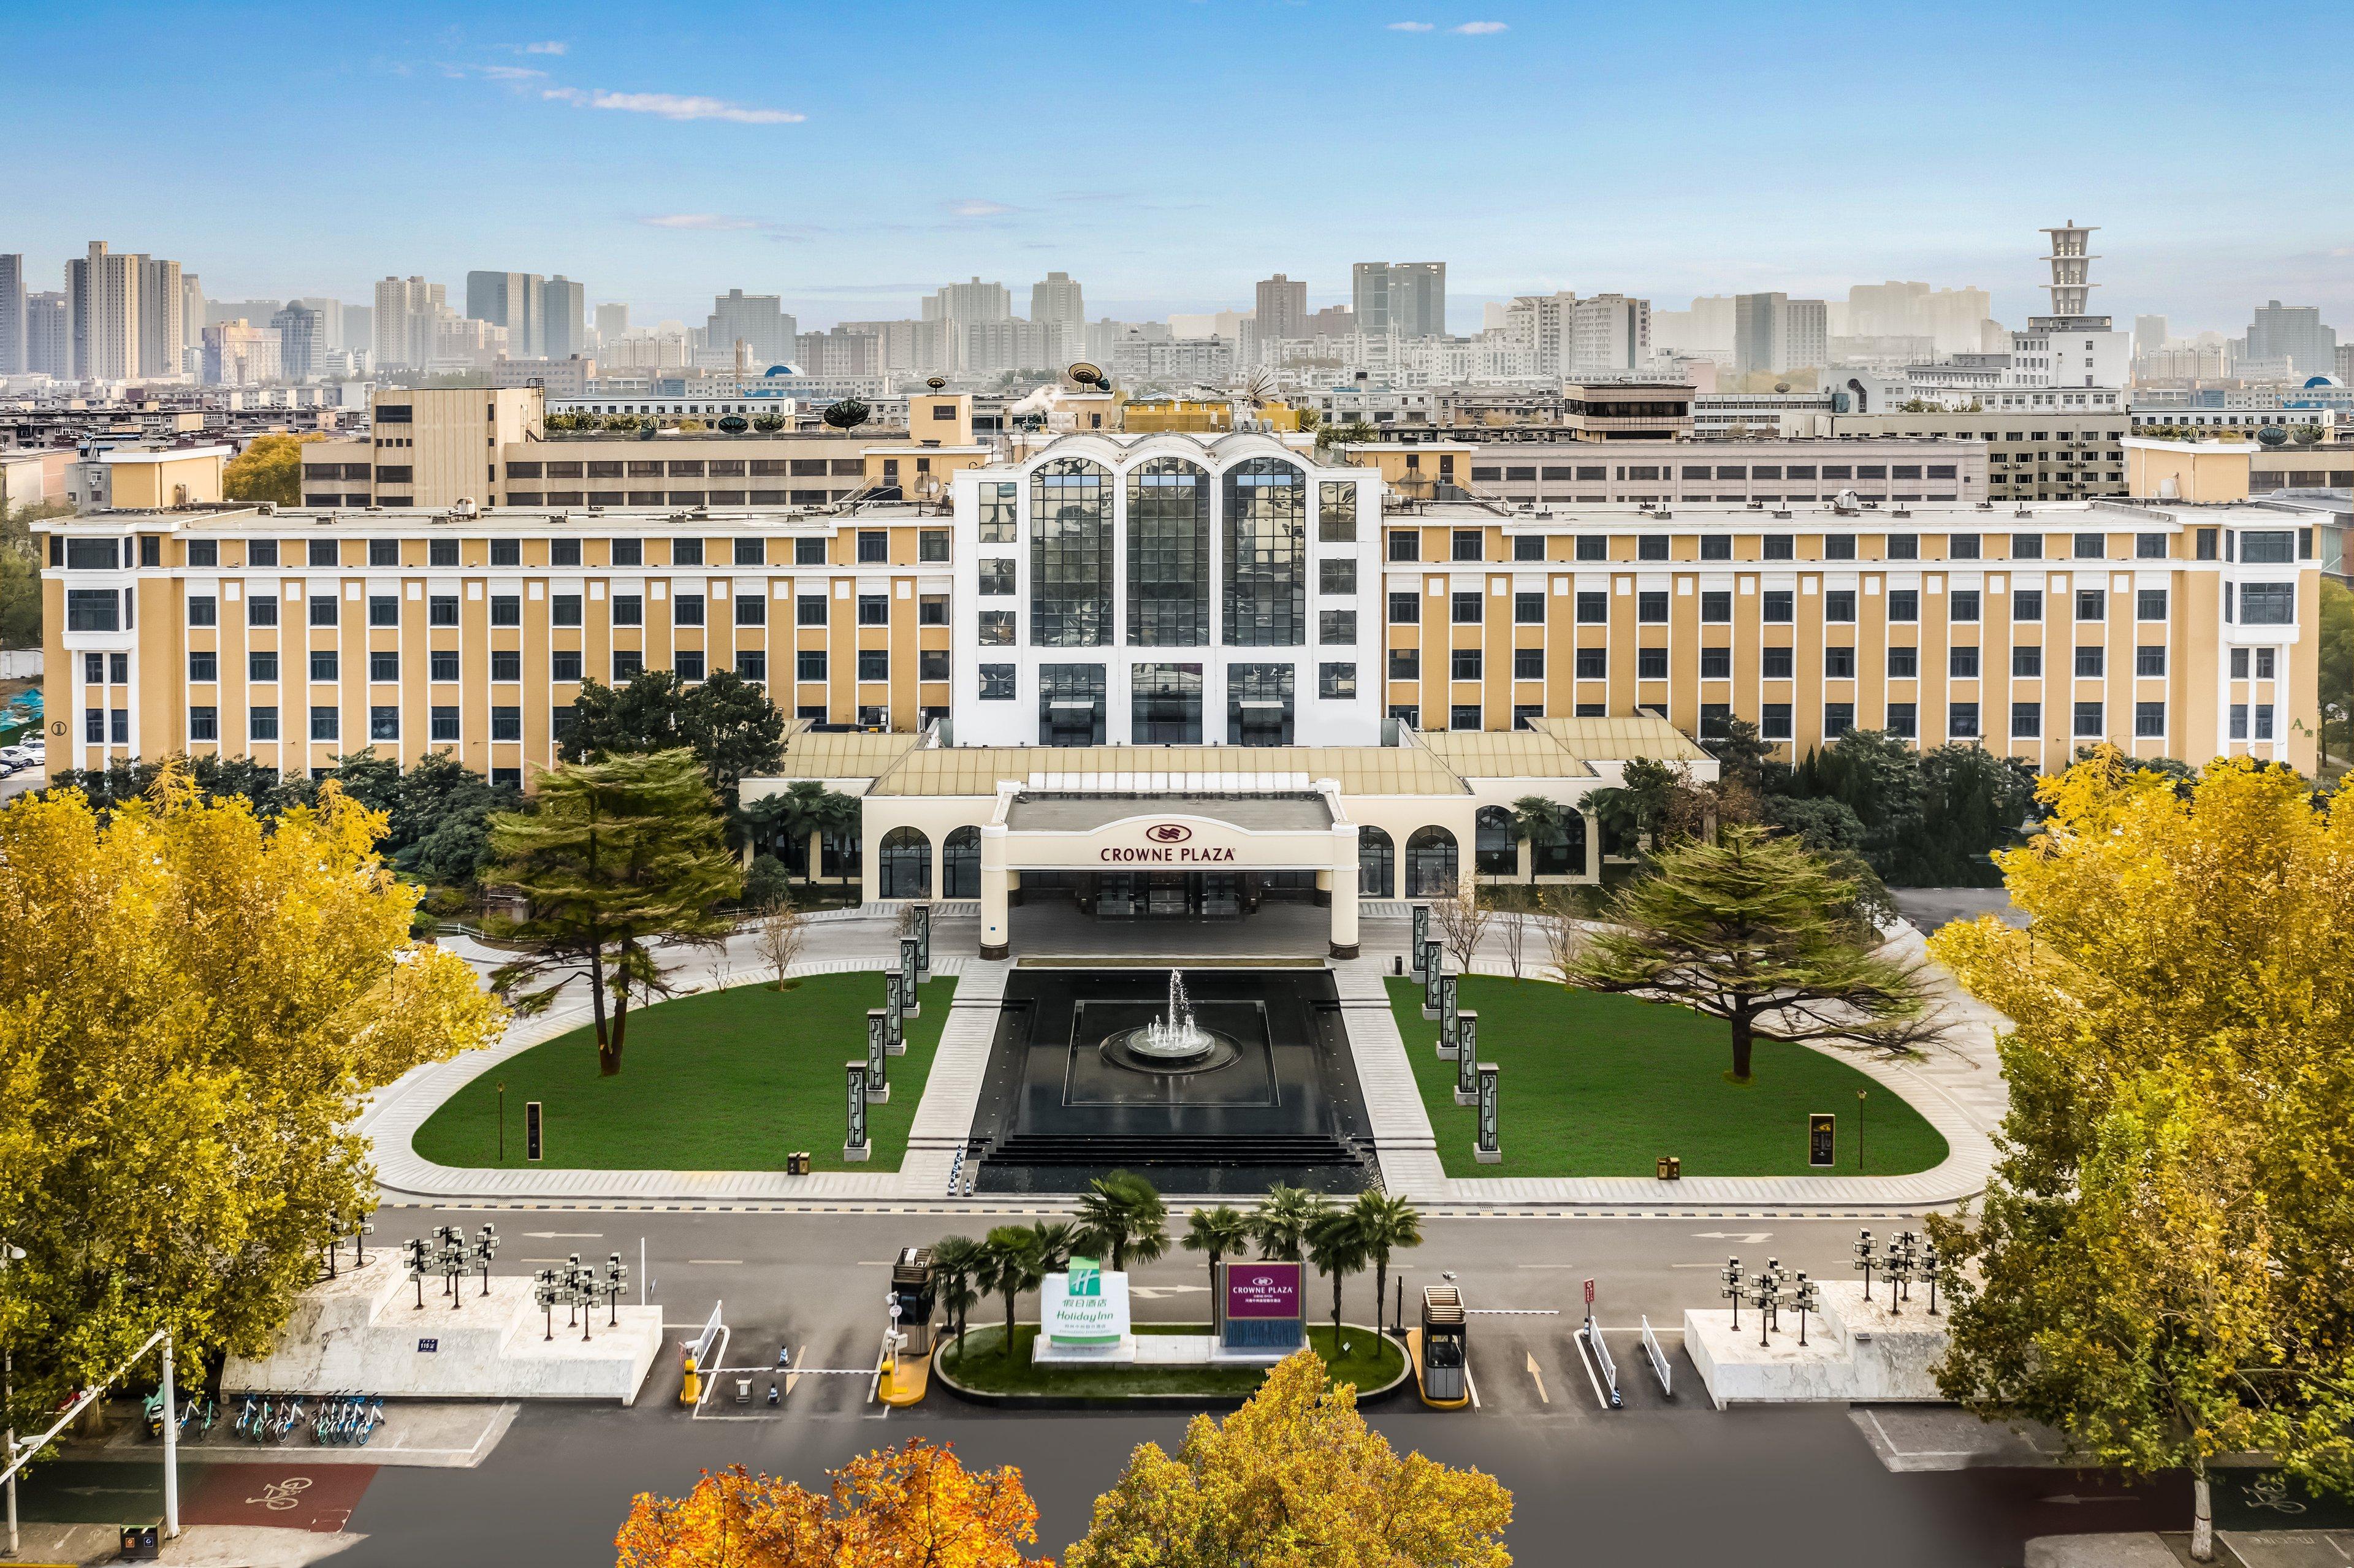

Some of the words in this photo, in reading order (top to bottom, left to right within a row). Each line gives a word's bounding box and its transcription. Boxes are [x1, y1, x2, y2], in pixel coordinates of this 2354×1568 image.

[1101, 848, 1173, 861] CROWNE
[1062, 1299, 1107, 1307] 假日酒店
[1057, 1311, 1096, 1323] Holiday
[1097, 1311, 1113, 1320] Inn
